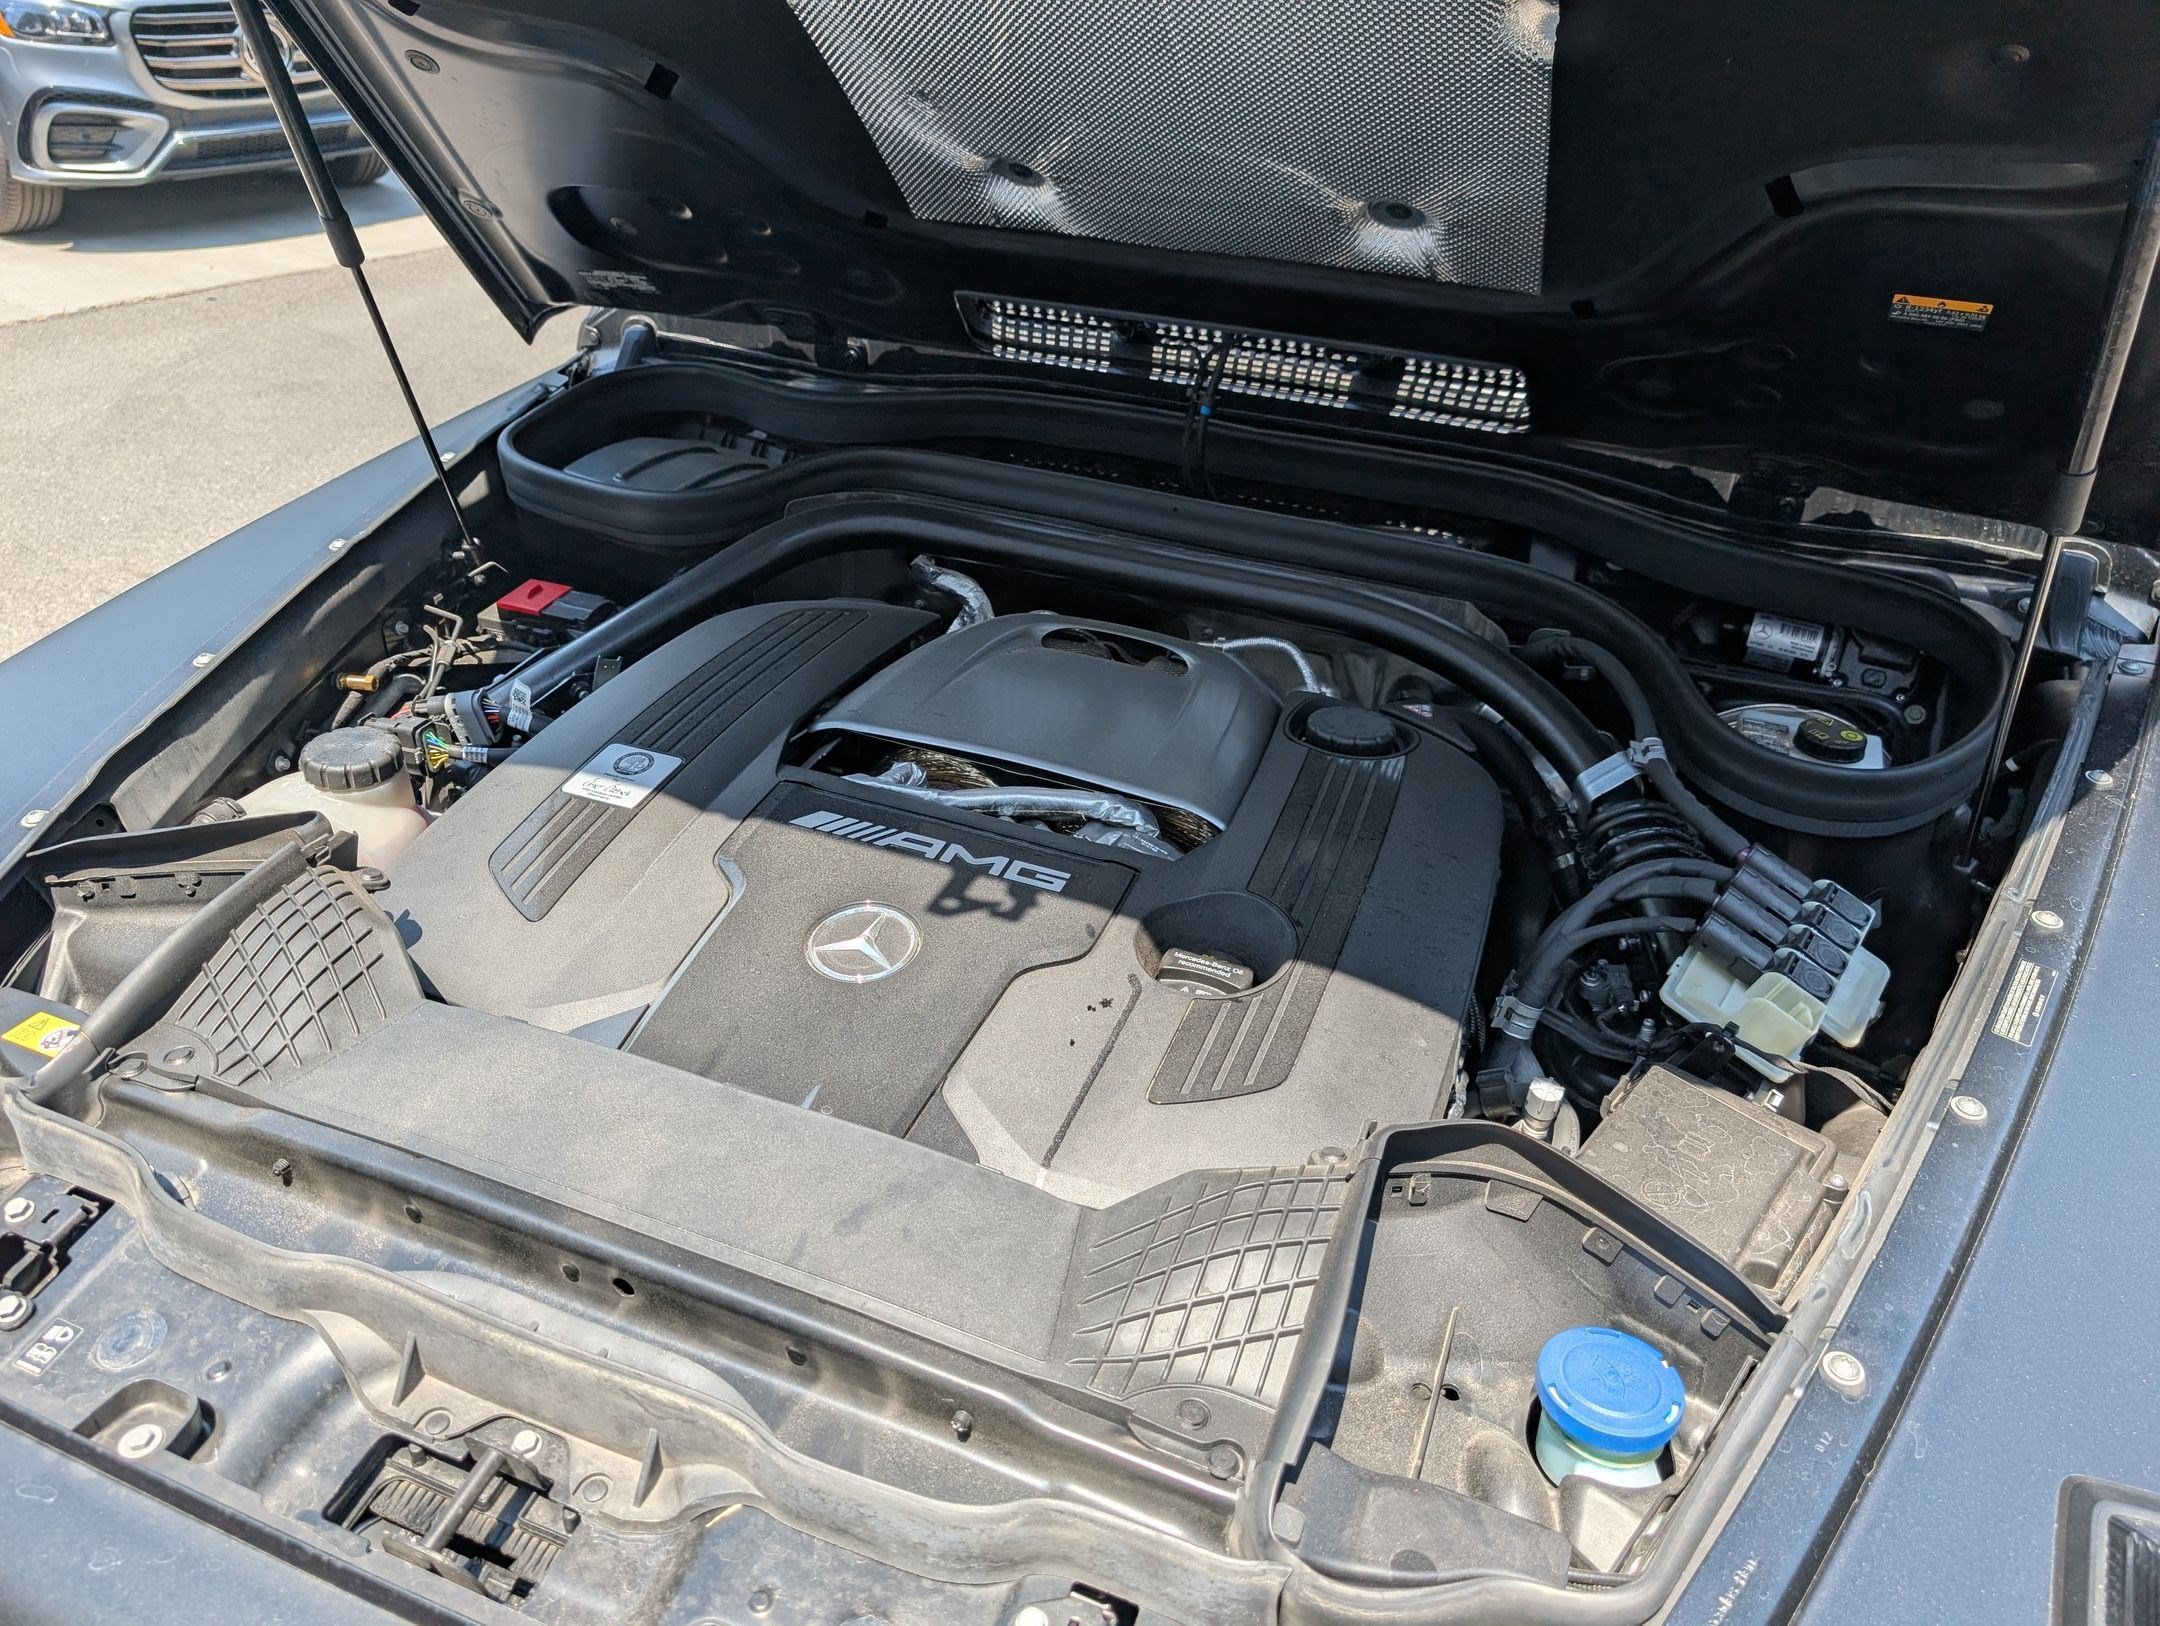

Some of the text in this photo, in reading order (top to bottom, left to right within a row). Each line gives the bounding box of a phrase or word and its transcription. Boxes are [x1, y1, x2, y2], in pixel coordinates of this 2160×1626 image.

[875, 830, 1071, 892] AMG
[1174, 951, 1244, 976] Mercedes-Benz Oil
[1177, 959, 1231, 978] recommended
